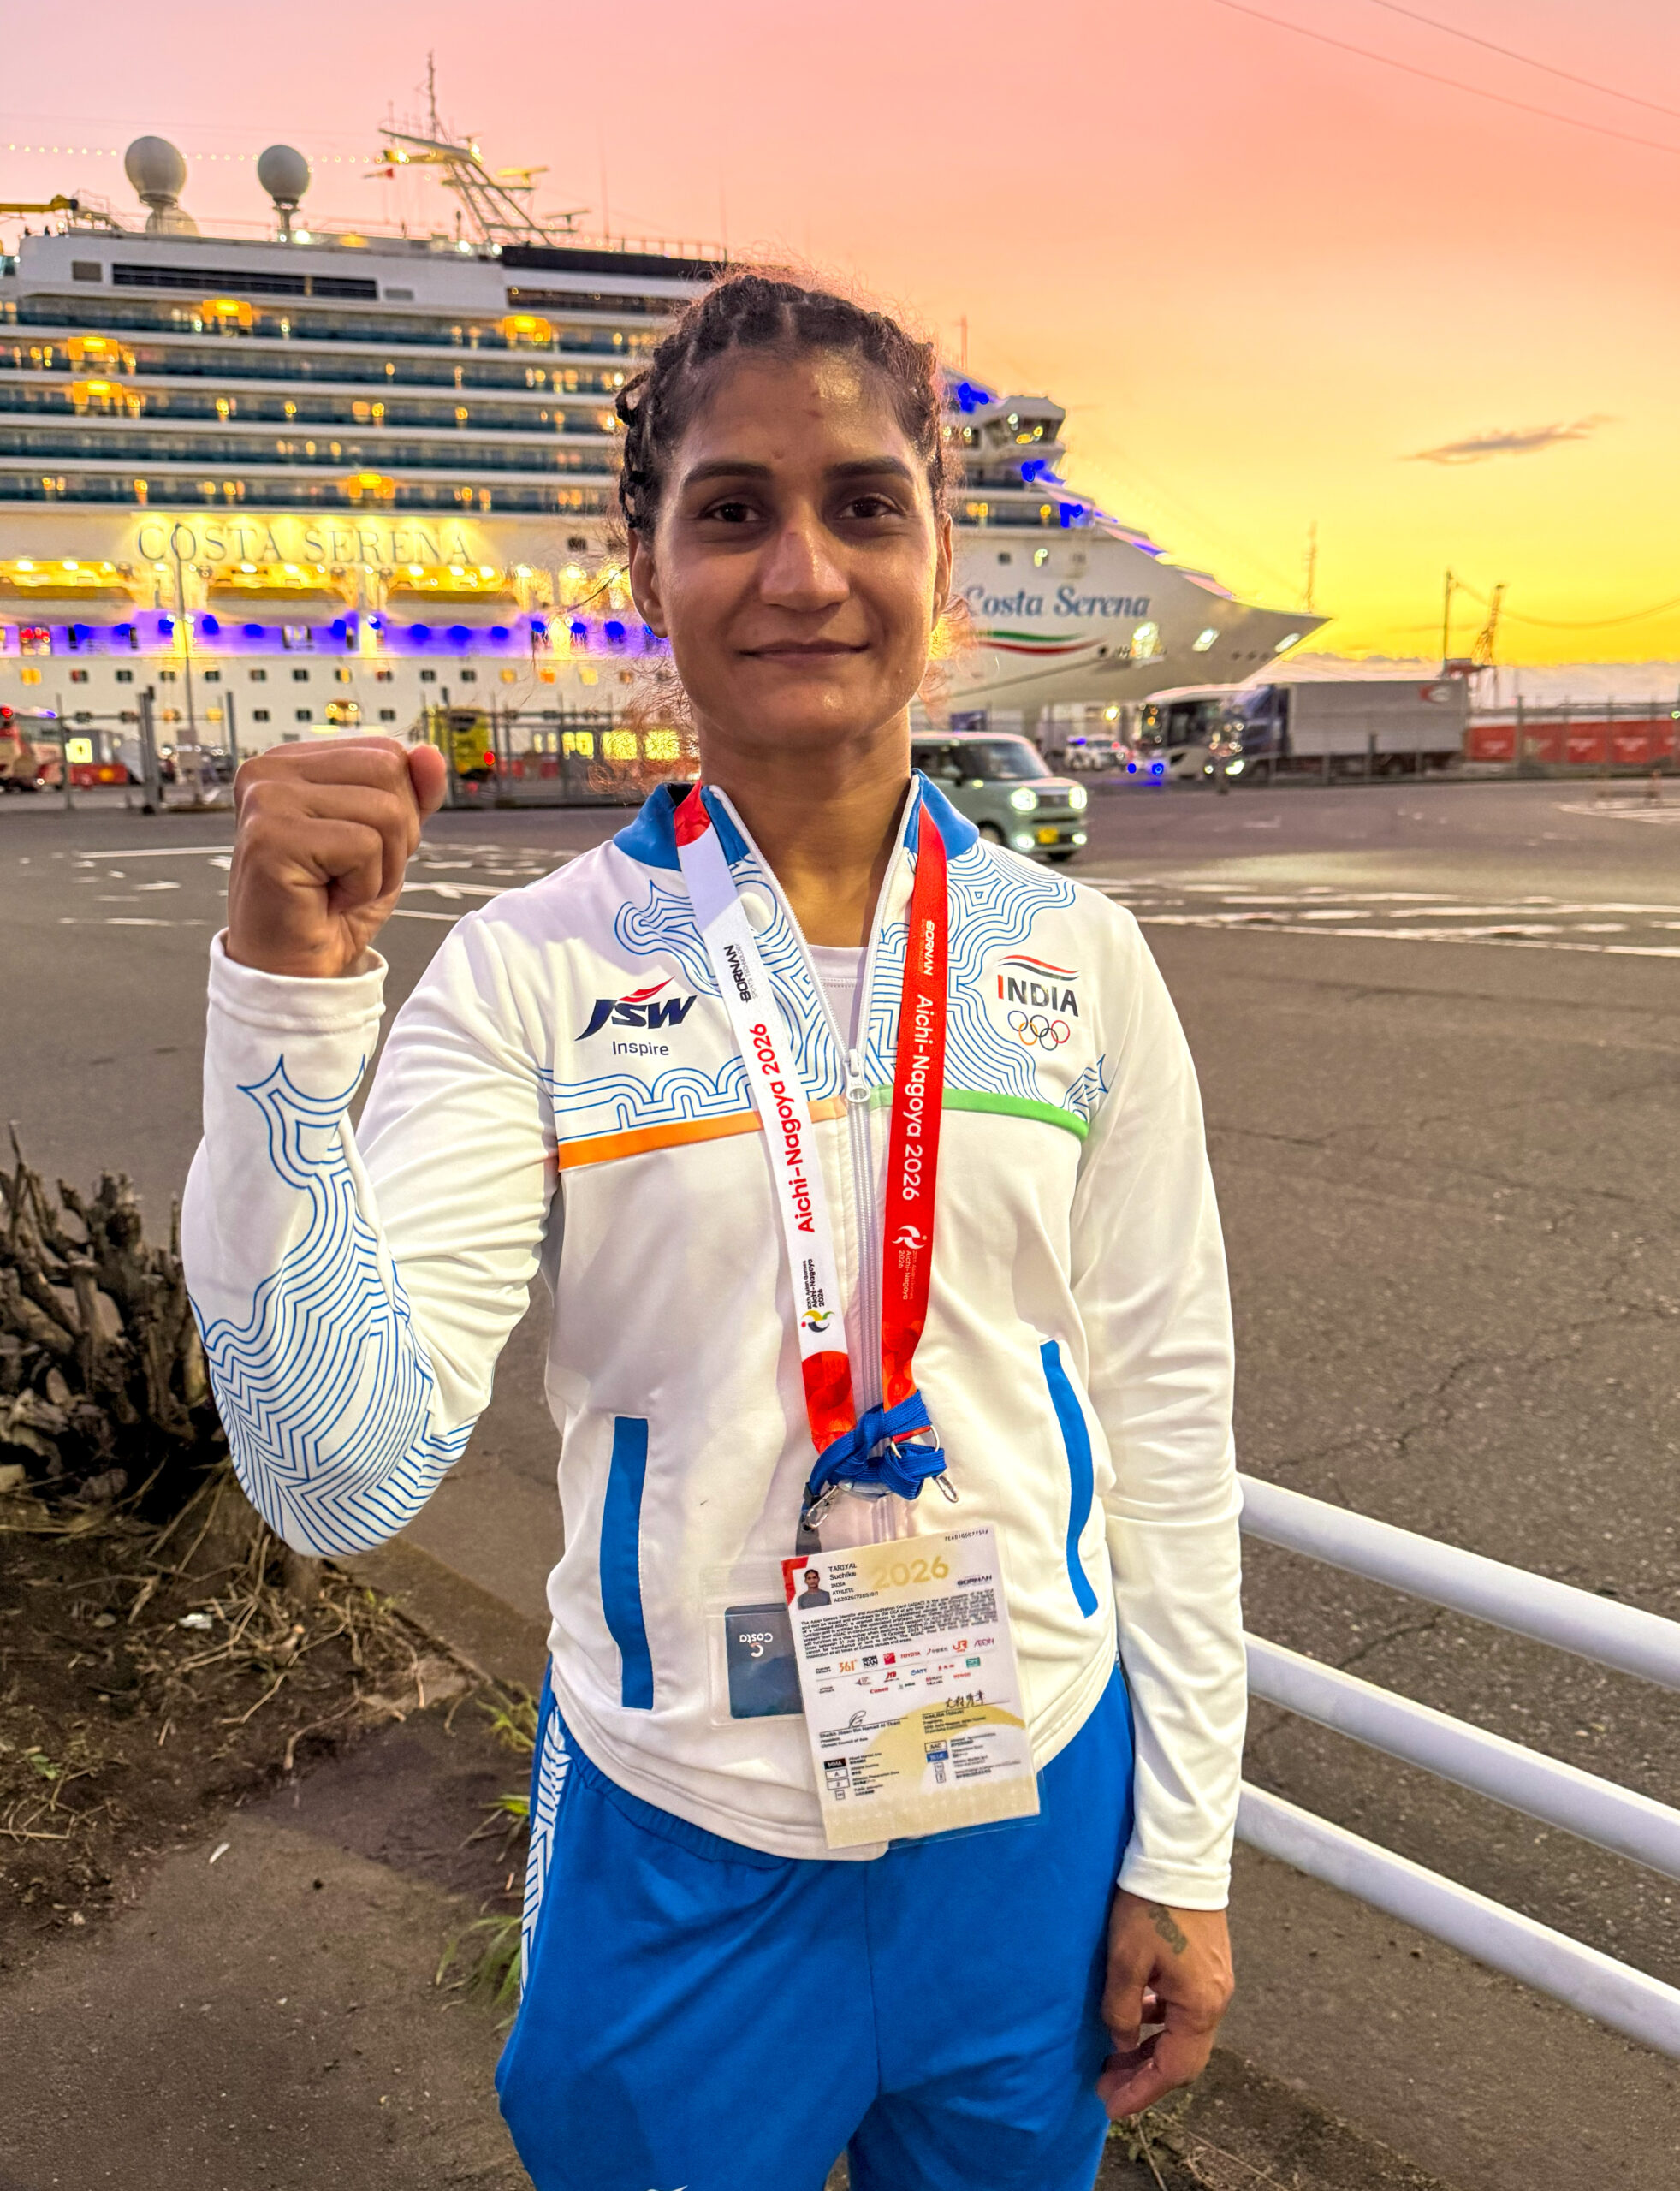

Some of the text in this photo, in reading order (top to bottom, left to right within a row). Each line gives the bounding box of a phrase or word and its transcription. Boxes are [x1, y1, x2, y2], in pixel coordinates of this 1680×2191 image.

[138, 523, 477, 564] COSTA SERENA
[965, 584, 1150, 618] Costa Serena
[923, 920, 935, 976] BORNAN
[724, 945, 751, 1003] BORNAN
[997, 974, 1078, 1017] INDIA
[574, 995, 698, 1041] JSW
[612, 1041, 669, 1056] Inspire
[903, 994, 935, 1200] Aichi-Nagoya 2026
[749, 1024, 815, 1232] Aichi-Nagoya 2026
[870, 1555, 950, 1591] 2026
[739, 1632, 773, 1643] Costa
